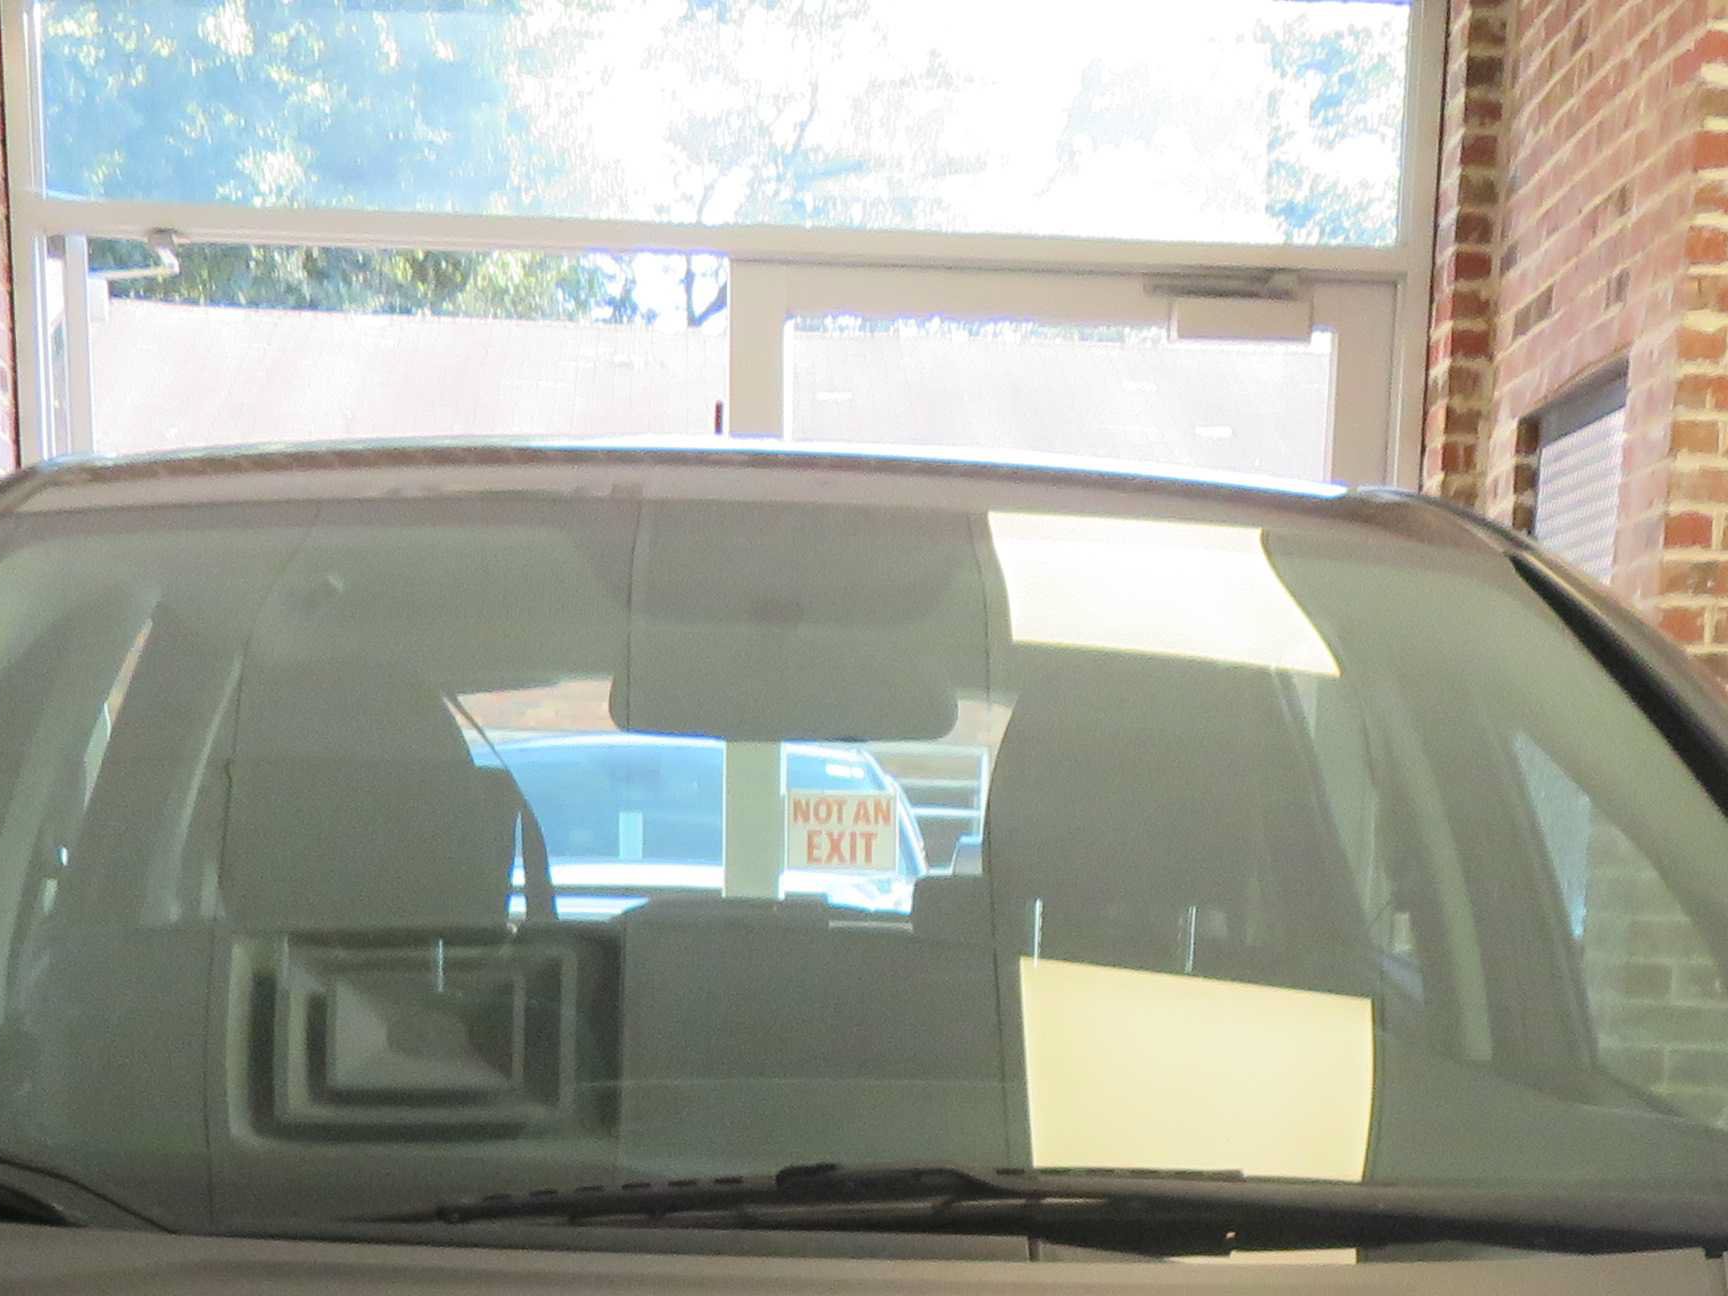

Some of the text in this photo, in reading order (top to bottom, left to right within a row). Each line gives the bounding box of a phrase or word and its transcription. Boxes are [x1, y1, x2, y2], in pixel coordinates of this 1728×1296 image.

[792, 797, 892, 825] NOT AN
[806, 830, 878, 865] EXIT
